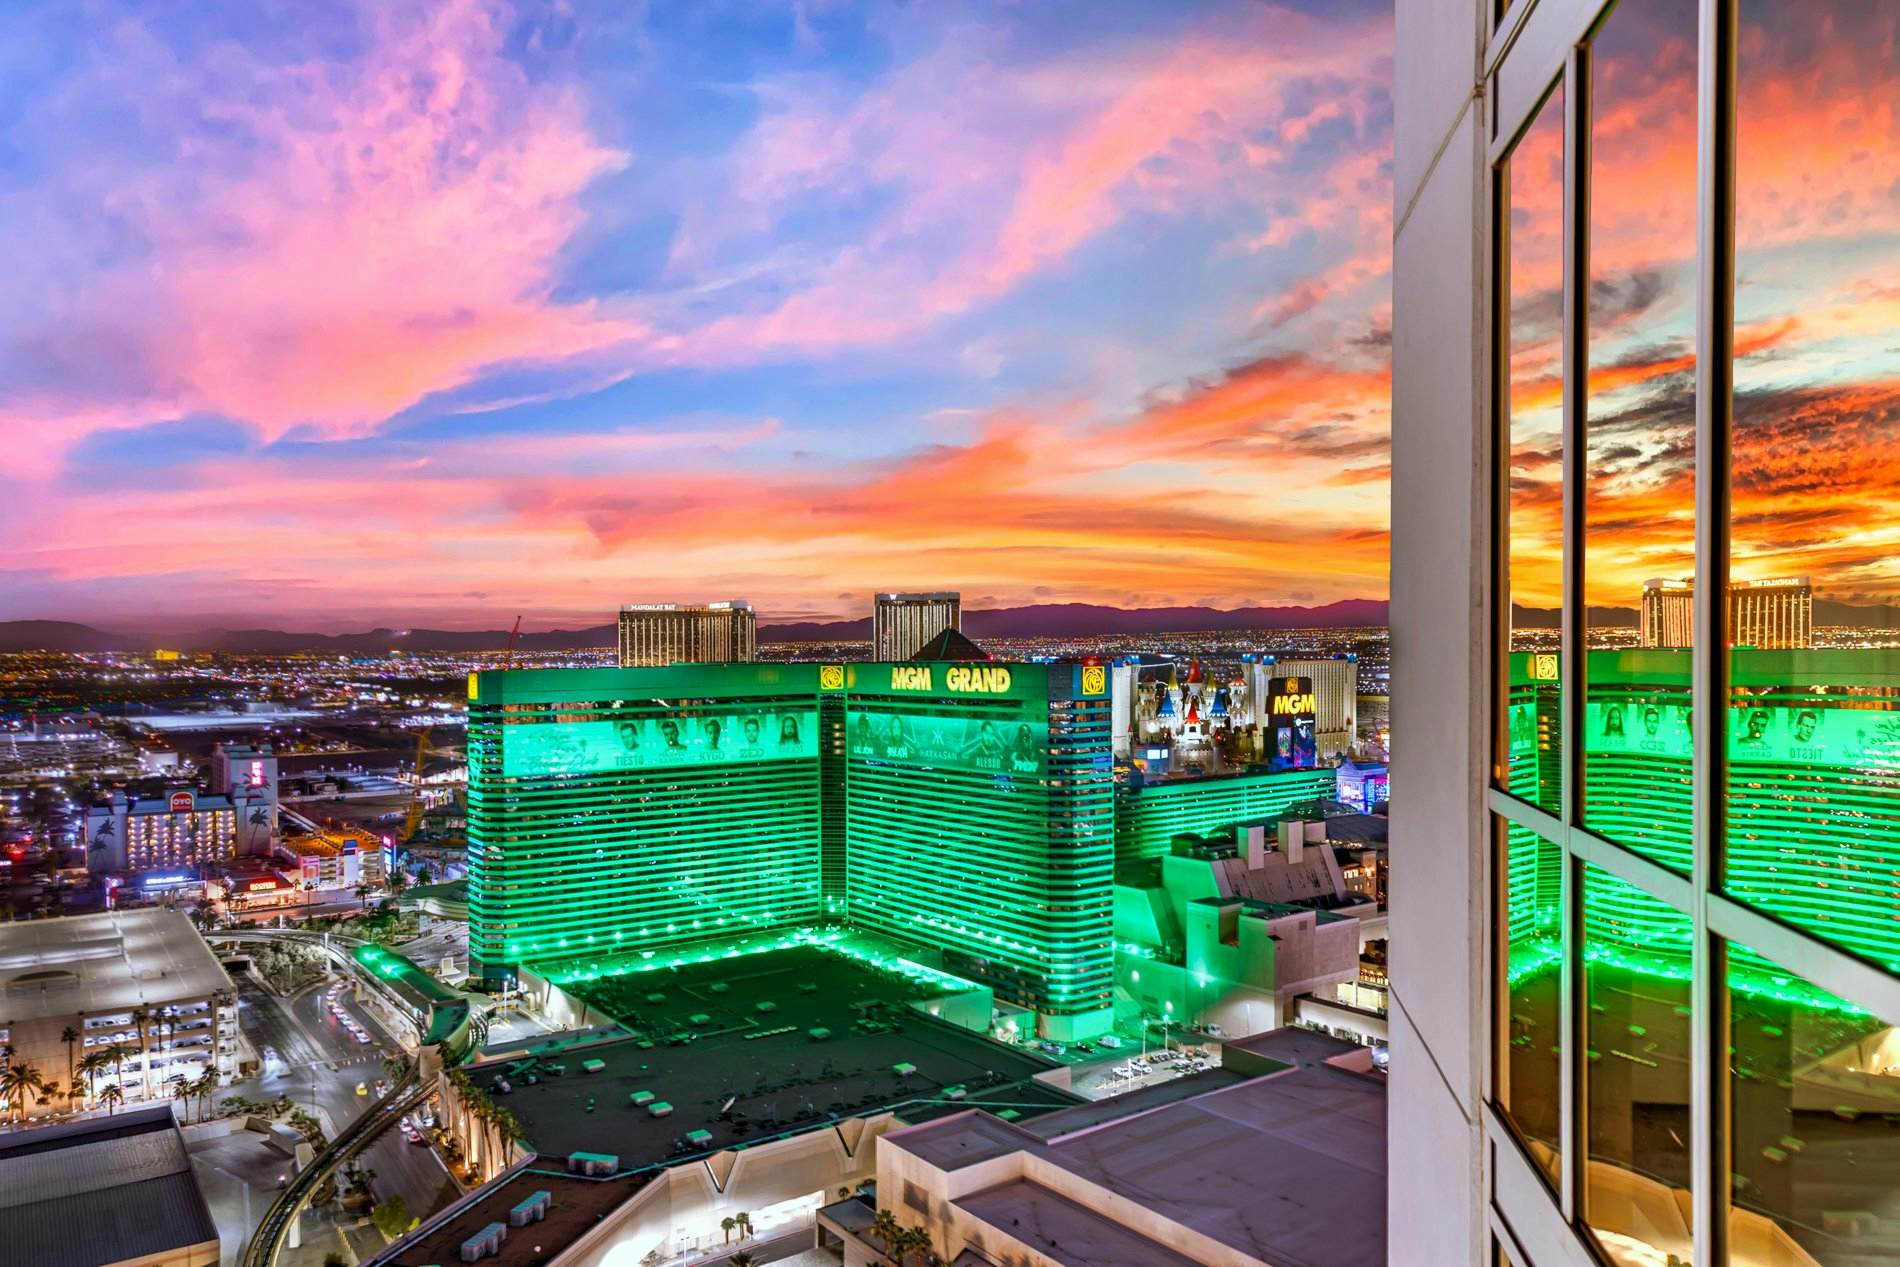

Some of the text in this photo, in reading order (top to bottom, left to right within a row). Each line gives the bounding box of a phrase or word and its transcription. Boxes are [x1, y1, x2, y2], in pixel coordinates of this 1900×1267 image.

[891, 666, 1011, 692] MGM GRAND
[1273, 693, 1316, 715] MGM
